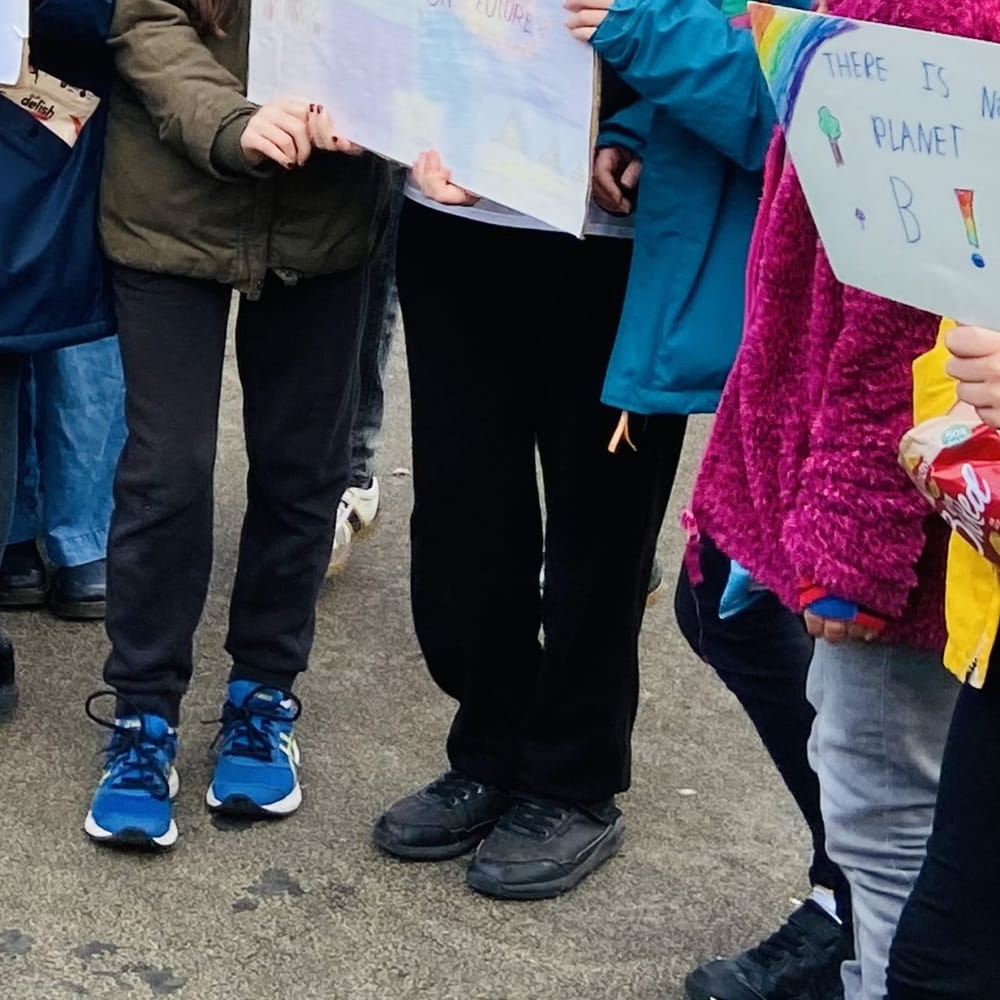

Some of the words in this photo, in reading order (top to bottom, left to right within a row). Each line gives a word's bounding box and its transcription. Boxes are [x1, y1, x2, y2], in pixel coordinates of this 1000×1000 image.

[822, 51, 888, 82] THERE
[921, 60, 950, 99] IS
[871, 114, 964, 158] PLANET
